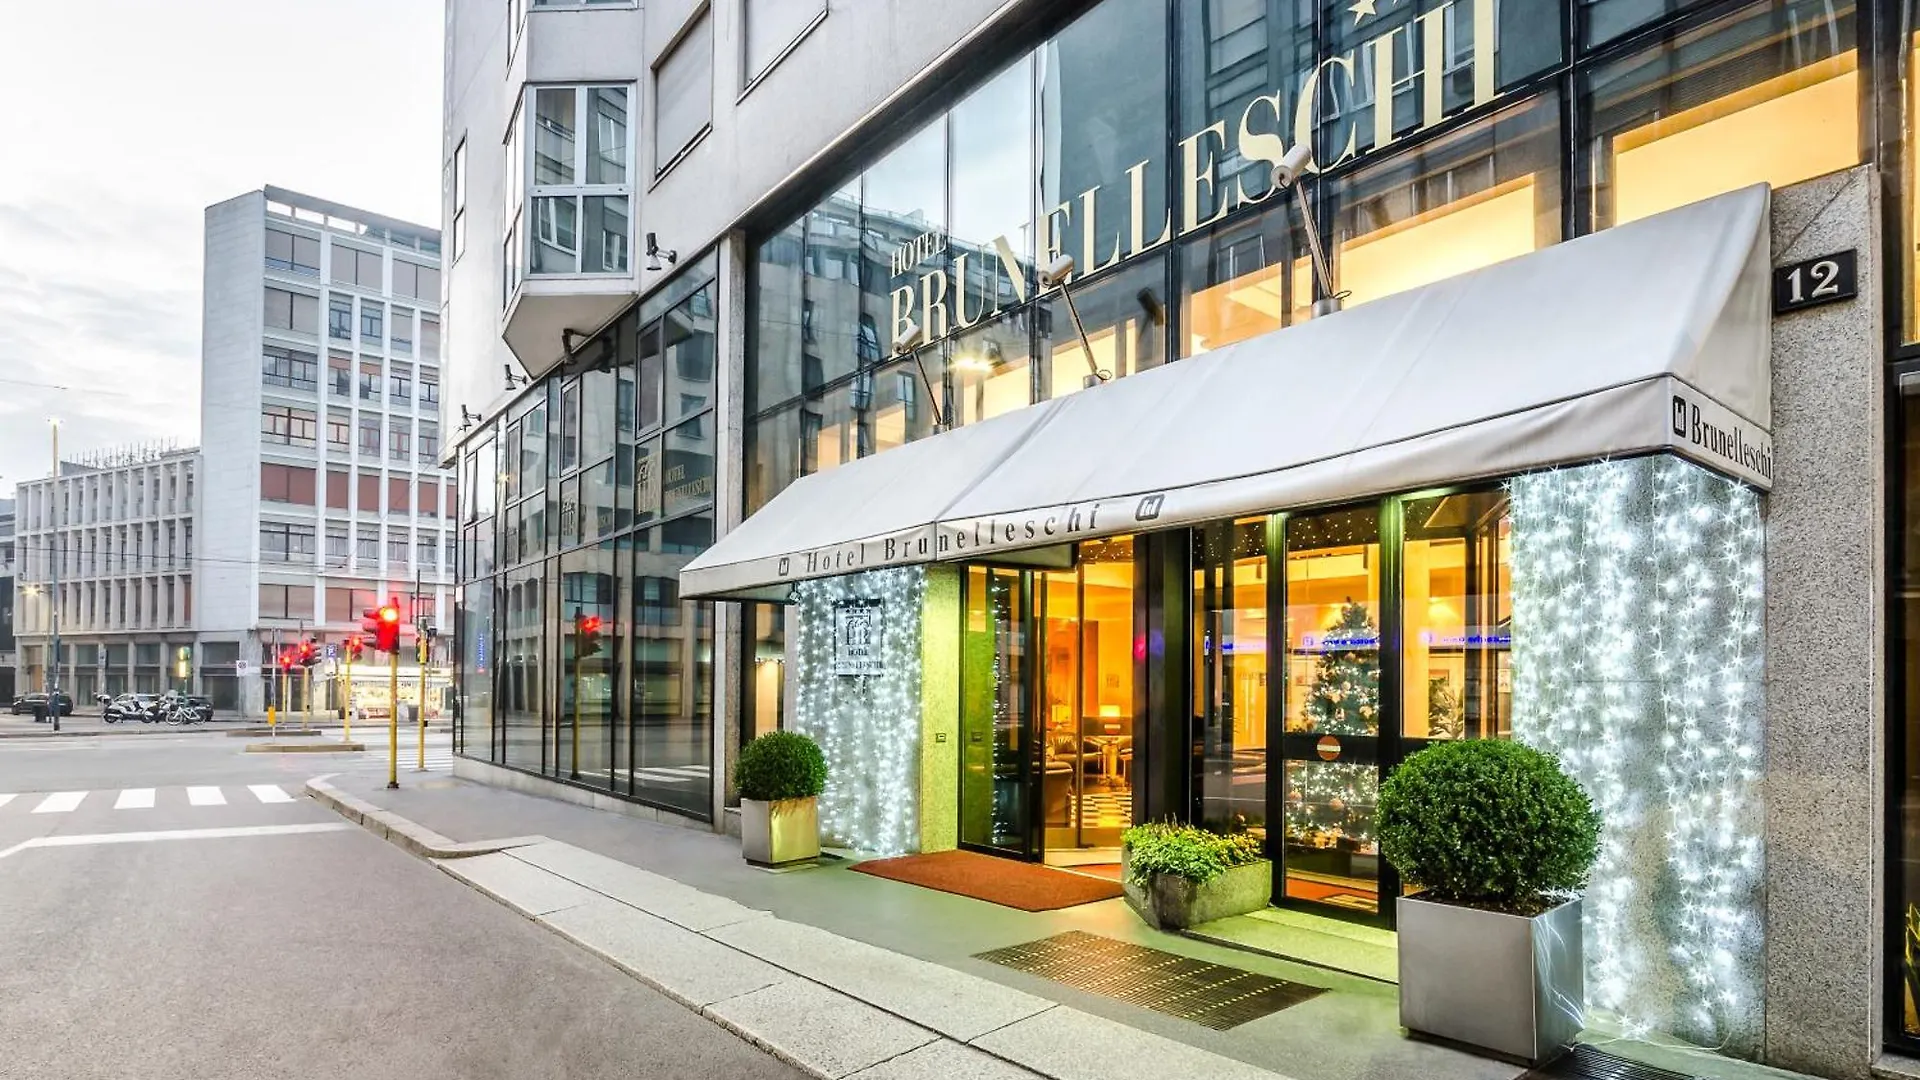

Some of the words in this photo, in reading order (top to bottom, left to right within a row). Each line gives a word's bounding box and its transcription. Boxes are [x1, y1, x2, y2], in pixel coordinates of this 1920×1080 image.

[888, 0, 1505, 361] BRUNELLESCHI
[891, 231, 947, 279] HOTEL
[1787, 260, 1839, 303] 12
[1691, 403, 1771, 480] Brunelleschi
[806, 543, 865, 573] Hotel
[884, 504, 1100, 561] Brunelleschi
